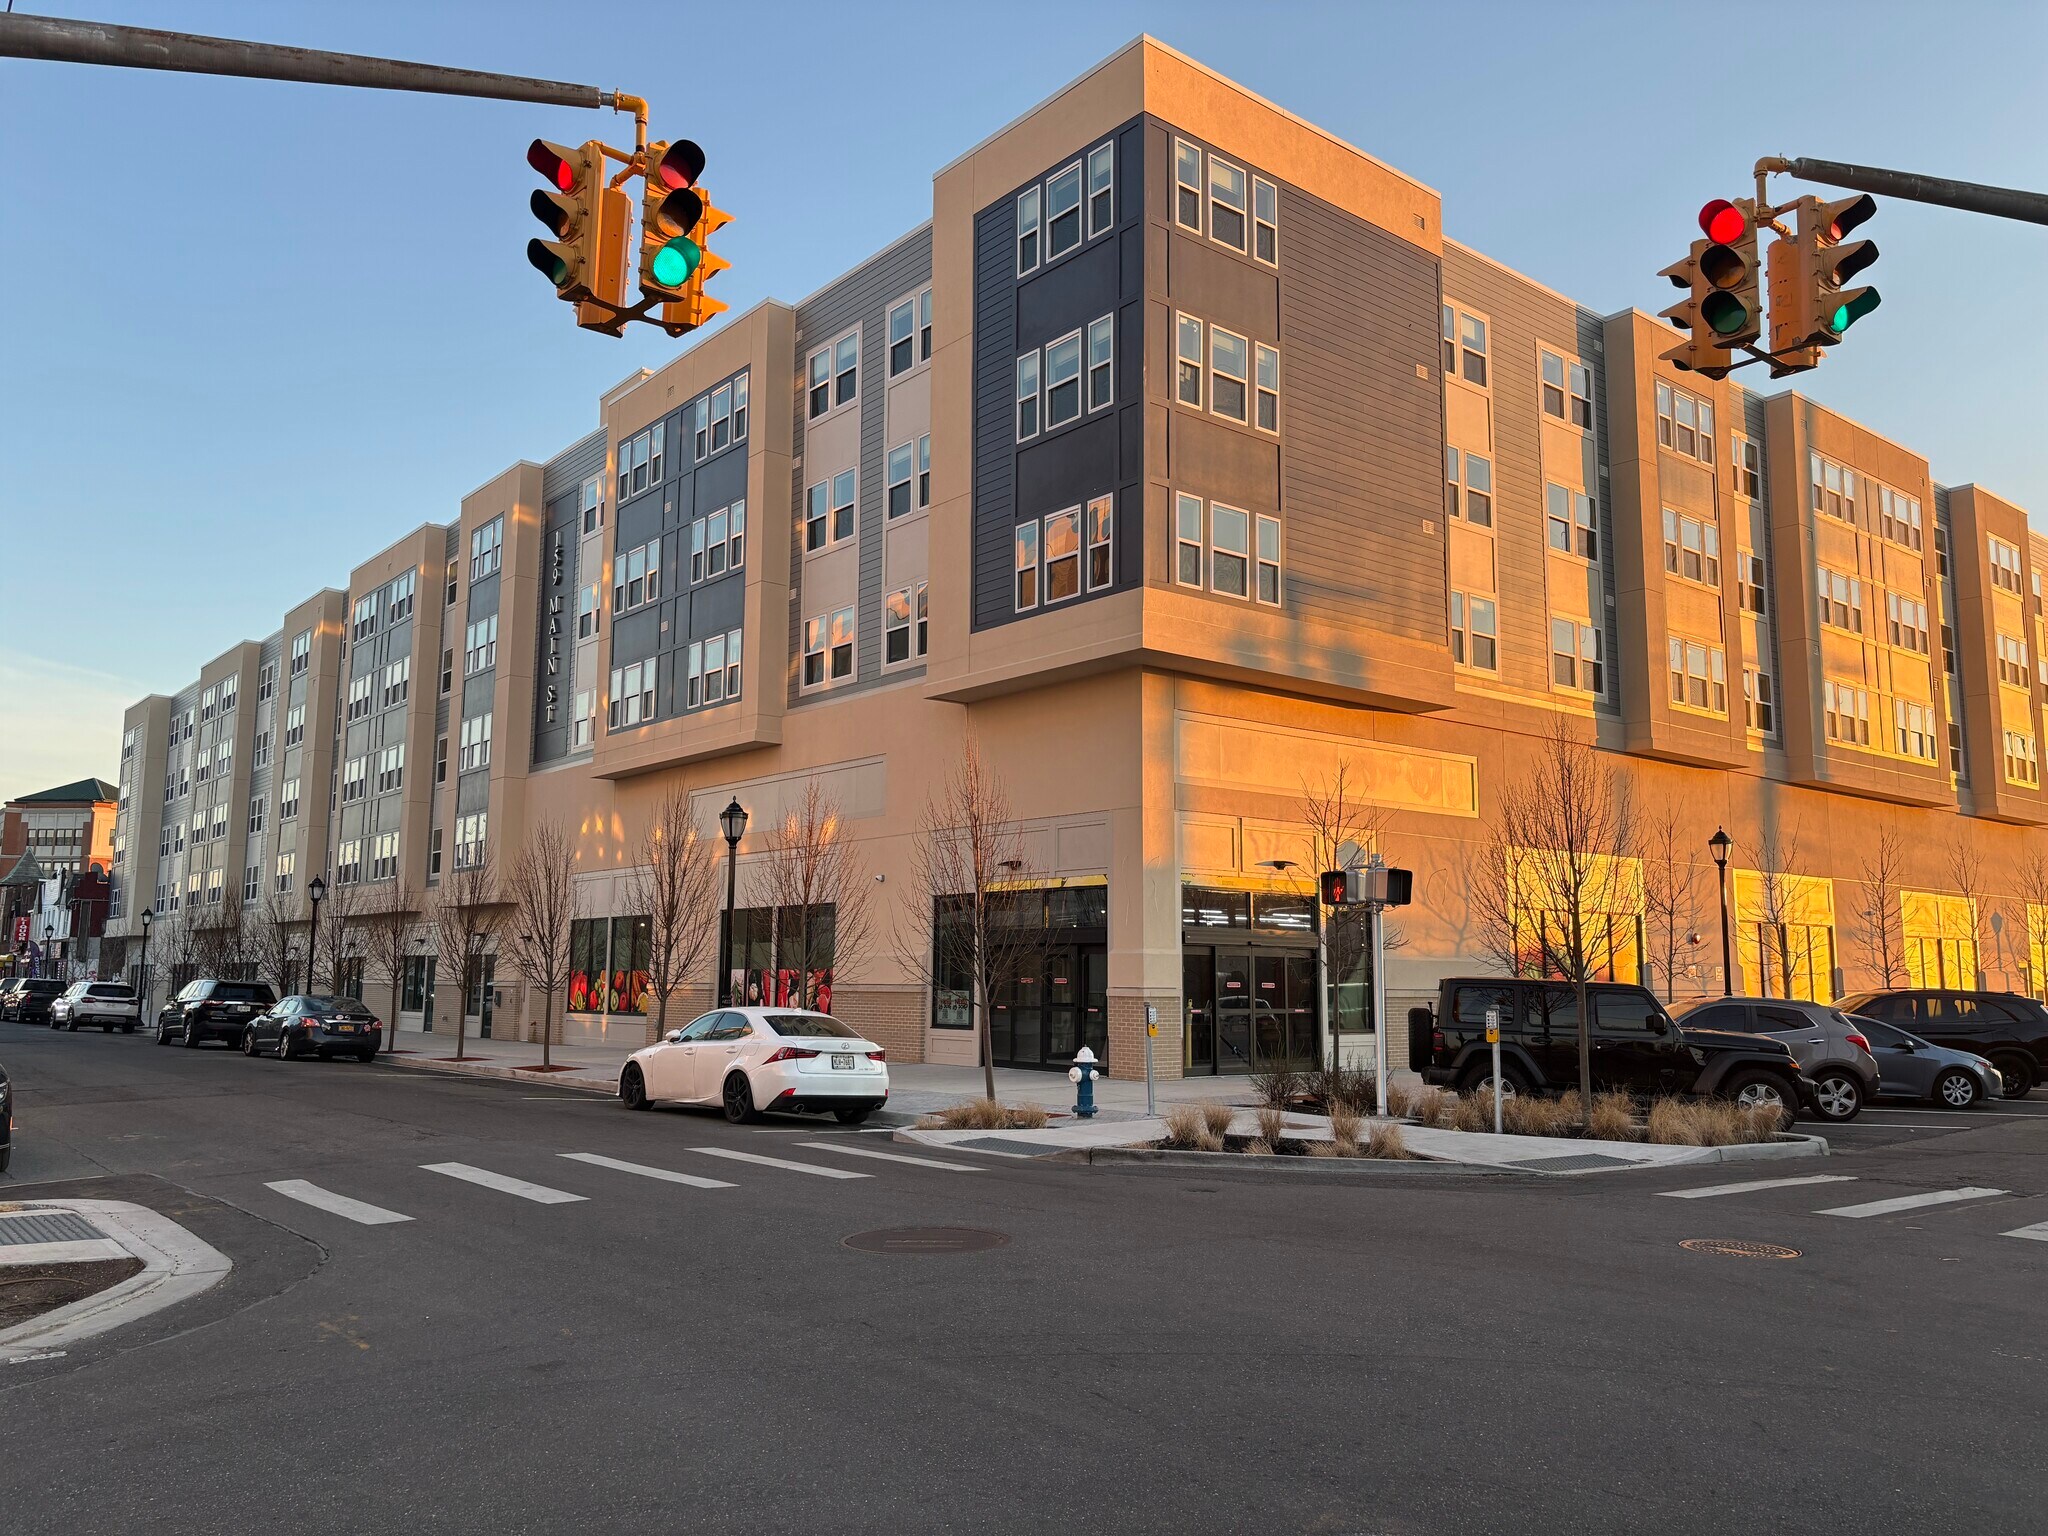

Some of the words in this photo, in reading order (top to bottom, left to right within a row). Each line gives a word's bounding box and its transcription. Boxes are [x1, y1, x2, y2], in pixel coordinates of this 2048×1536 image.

[552, 531, 562, 586] 159
[547, 595, 561, 675] MAIN
[546, 685, 556, 723] ST
